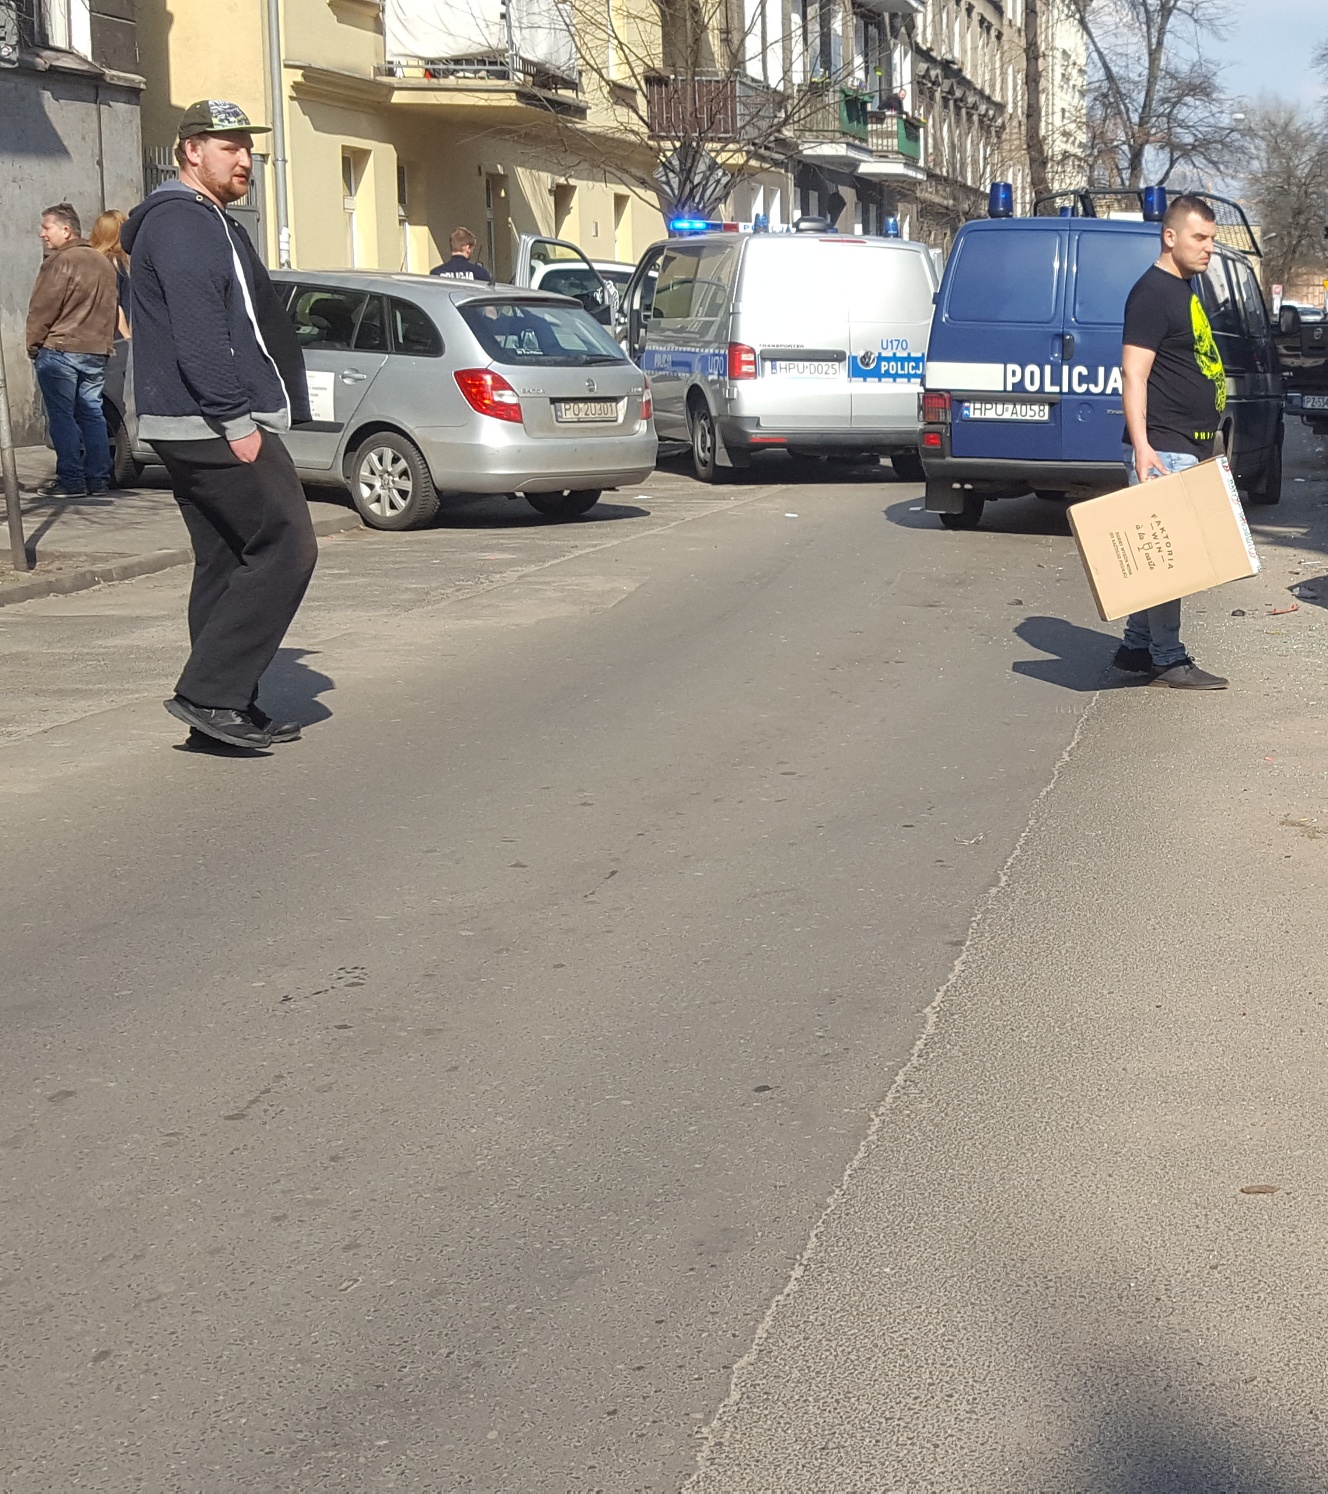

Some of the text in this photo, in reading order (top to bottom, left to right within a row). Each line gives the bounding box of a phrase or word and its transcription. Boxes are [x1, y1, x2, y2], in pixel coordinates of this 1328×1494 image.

[880, 338, 909, 351] U170
[778, 363, 838, 376] HPU D025
[564, 402, 580, 417] PO
[973, 401, 1046, 419] HPU A058
[1150, 513, 1174, 570] FAKTORIA
[1151, 531, 1163, 553] WIN
